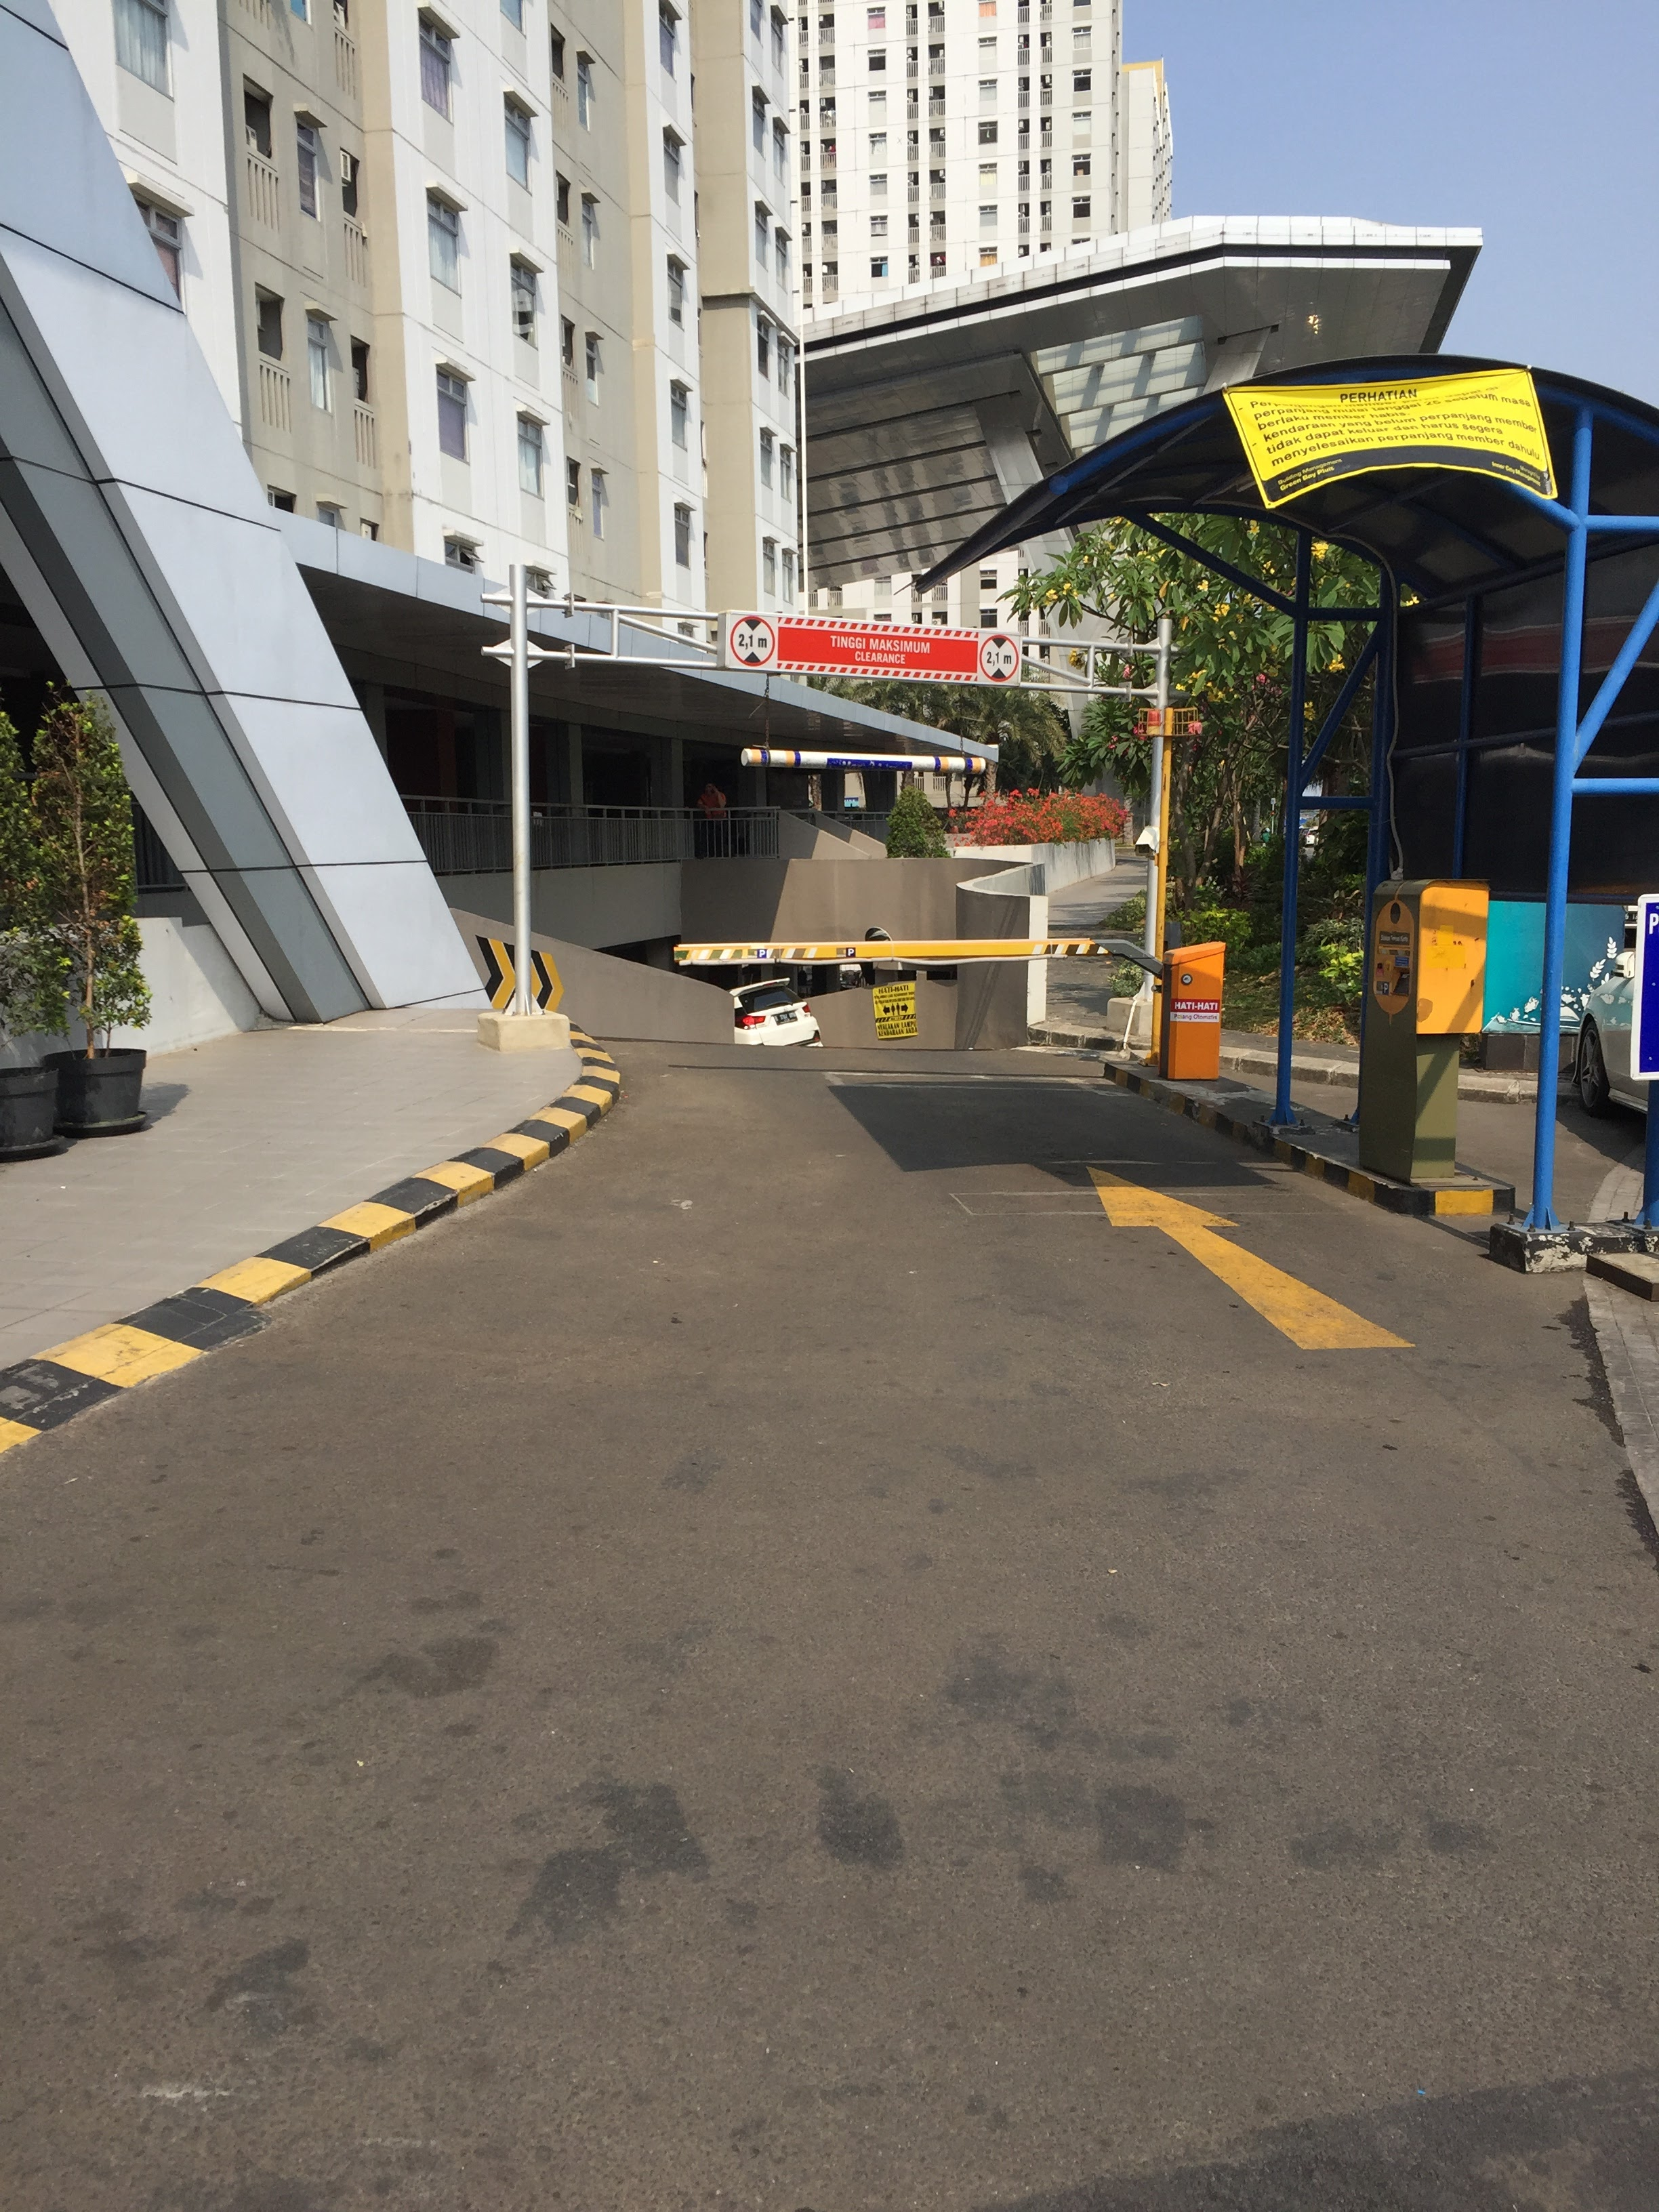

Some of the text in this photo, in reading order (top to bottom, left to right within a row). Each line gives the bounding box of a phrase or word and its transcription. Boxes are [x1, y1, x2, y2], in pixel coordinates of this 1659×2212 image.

[1340, 389, 1417, 403] PERHATIAN
[1254, 408, 1330, 421] perpanjang
[1372, 403, 1421, 411] tanggal
[1445, 394, 1498, 403] sebelum
[1501, 396, 1531, 407] masa
[1258, 415, 1309, 430] berlaku
[1263, 422, 1336, 442] kendaraan
[1420, 412, 1492, 424] perpanjang
[1495, 417, 1536, 432] member
[1267, 437, 1302, 454] tidak
[1305, 429, 1345, 441] dapat
[1462, 424, 1503, 434] segera
[1271, 436, 1374, 466] menyelesaikan
[1378, 432, 1453, 443] perpanjang
[1456, 434, 1504, 445] member
[1279, 478, 1302, 491] Green
[1303, 472, 1316, 480] Bay
[739, 634, 767, 650] 2,1 m
[830, 635, 930, 653] TINGGI MAKSIMUM
[855, 651, 906, 664] CLEARANCE
[987, 651, 1012, 666] 2,1 m
[878, 985, 909, 994] HATI-HATI
[1174, 1002, 1218, 1010] HATI-HATI
